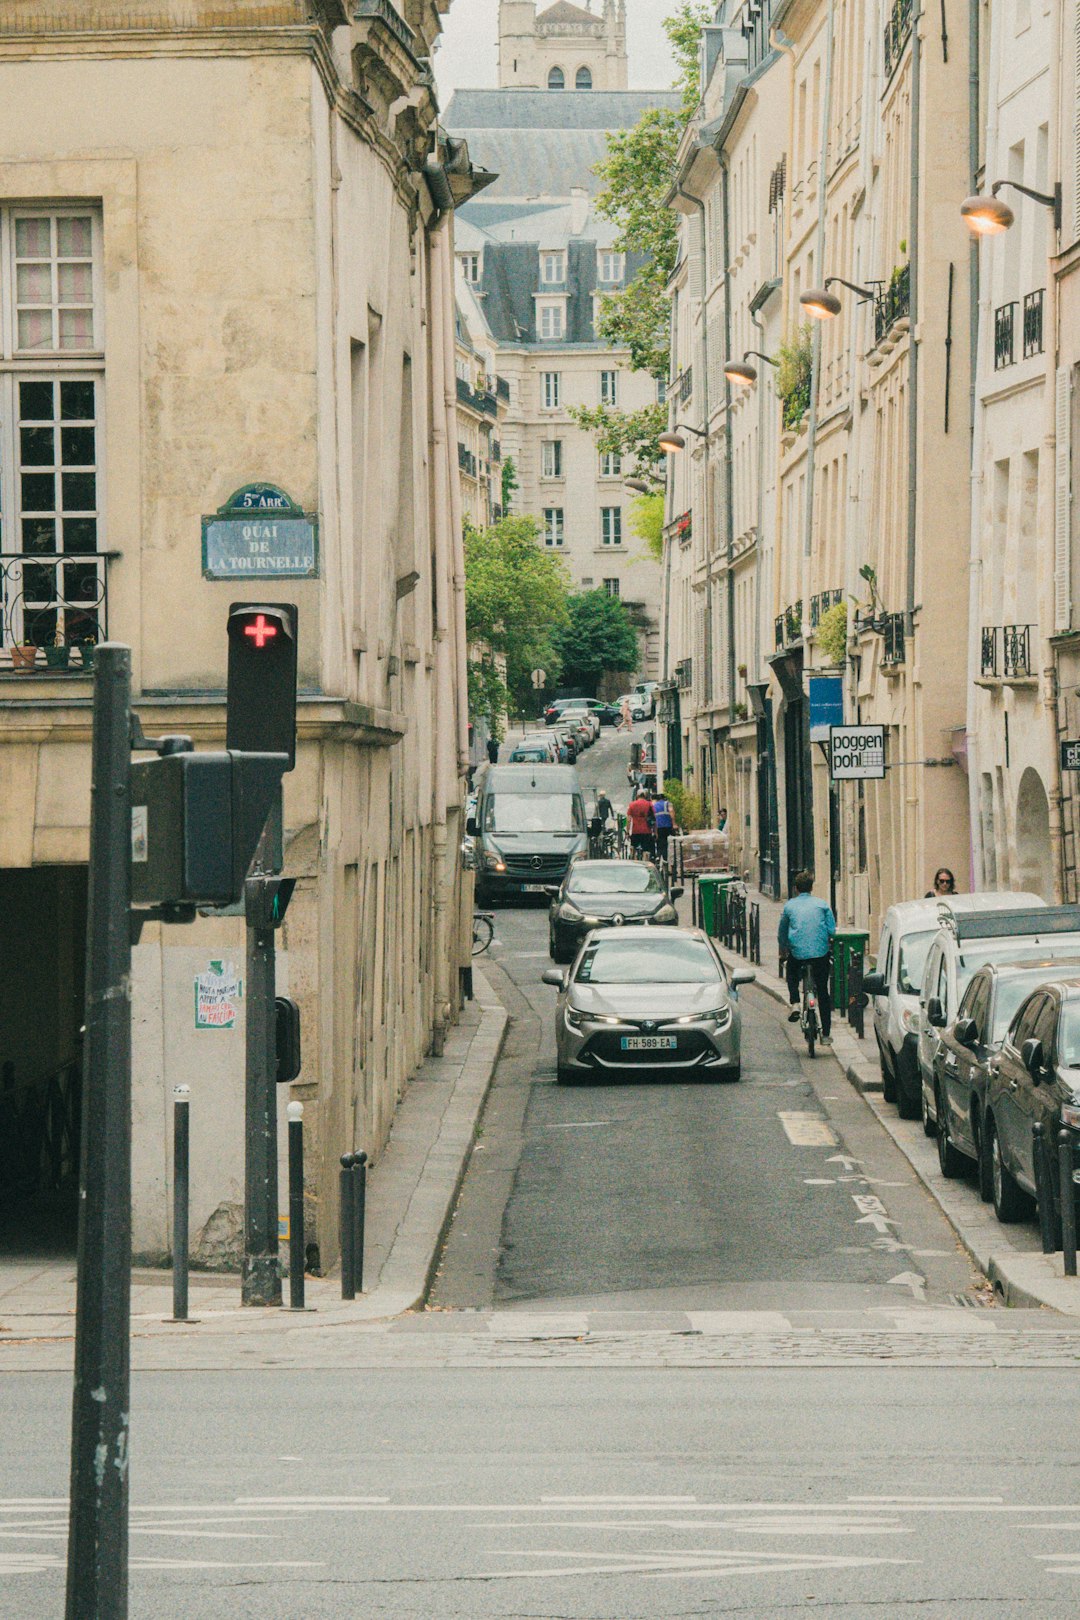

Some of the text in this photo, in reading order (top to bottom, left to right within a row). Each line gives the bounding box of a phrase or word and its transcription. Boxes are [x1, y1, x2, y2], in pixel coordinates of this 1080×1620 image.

[242, 525, 278, 539] QUAI
[249, 541, 269, 552] DE
[208, 556, 313, 569] LA TOURNELLE
[833, 735, 882, 752] poggen
[833, 752, 862, 771] pohl
